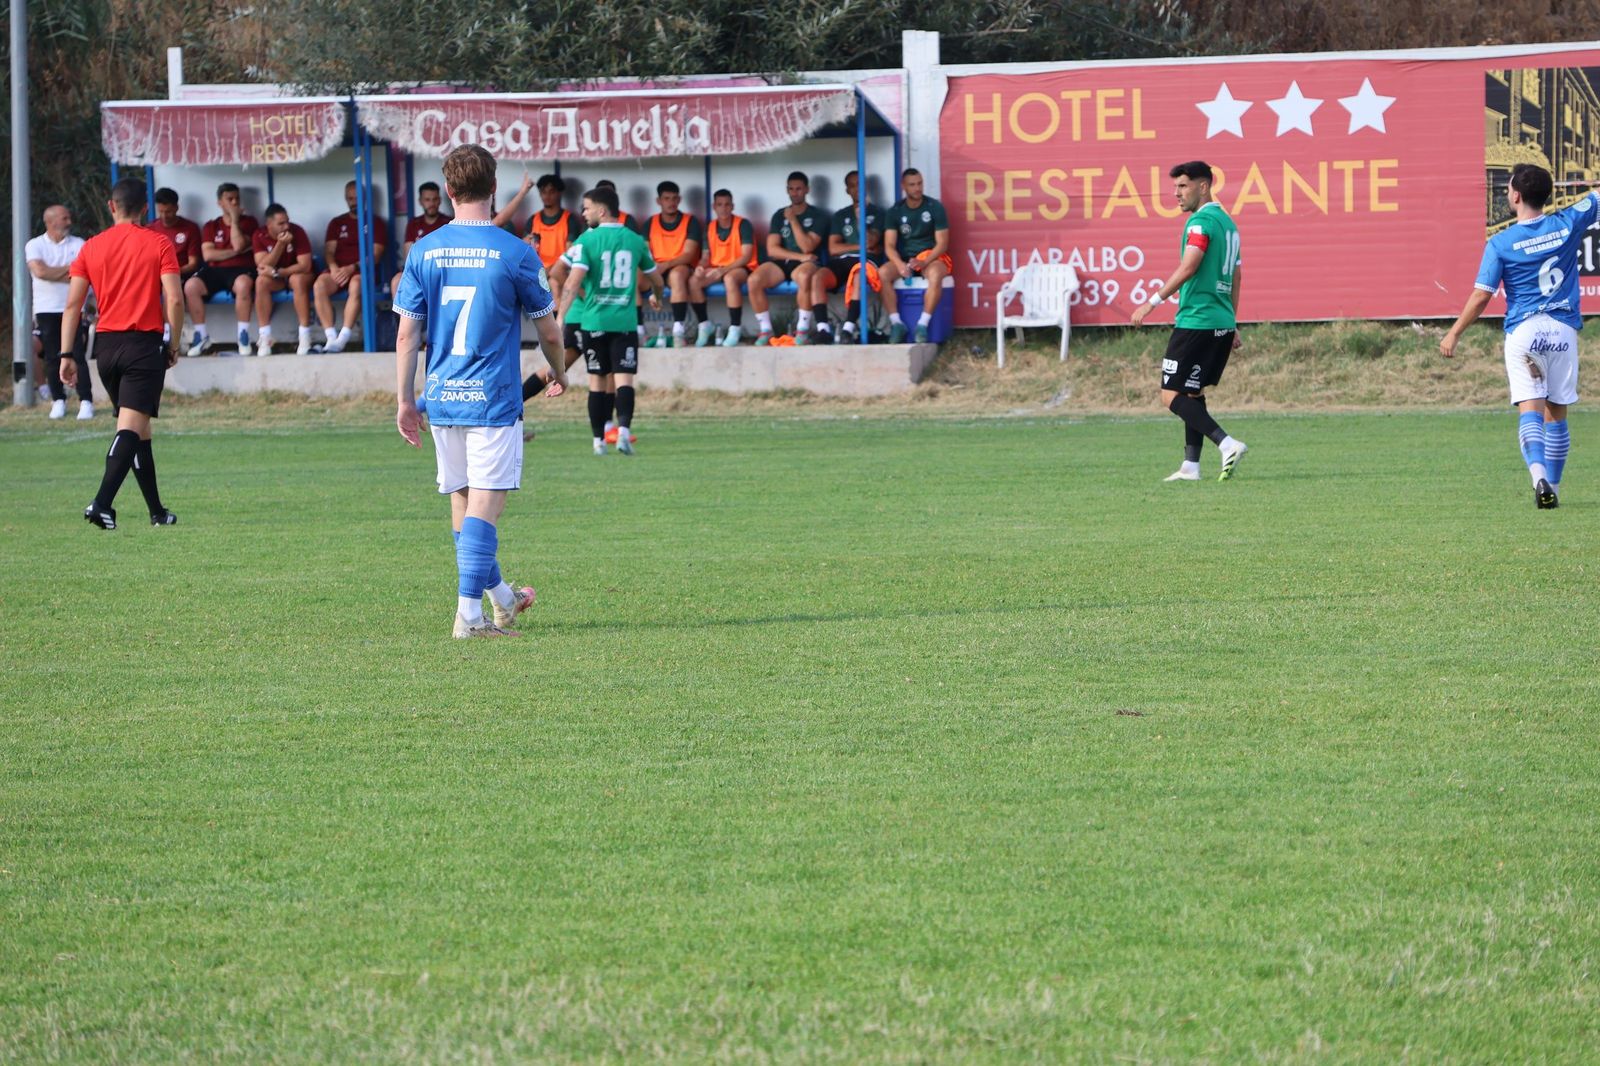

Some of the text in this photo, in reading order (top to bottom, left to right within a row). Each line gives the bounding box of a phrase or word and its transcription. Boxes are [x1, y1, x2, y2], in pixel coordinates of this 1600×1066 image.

[249, 114, 318, 136] HOTEL
[413, 104, 710, 153] Casa Aurelia
[965, 88, 1156, 144] HOTEL
[424, 248, 501, 261] AYUNTAMIENTO DE
[435, 258, 486, 268] VILLARALBO
[599, 249, 633, 289] 18
[967, 245, 1145, 276] VILLARALBO
[1538, 254, 1565, 297] 6
[967, 282, 989, 308] T.
[1129, 278, 1180, 305] 62
[441, 285, 477, 356] 7
[440, 390, 487, 402] ZAMORA
